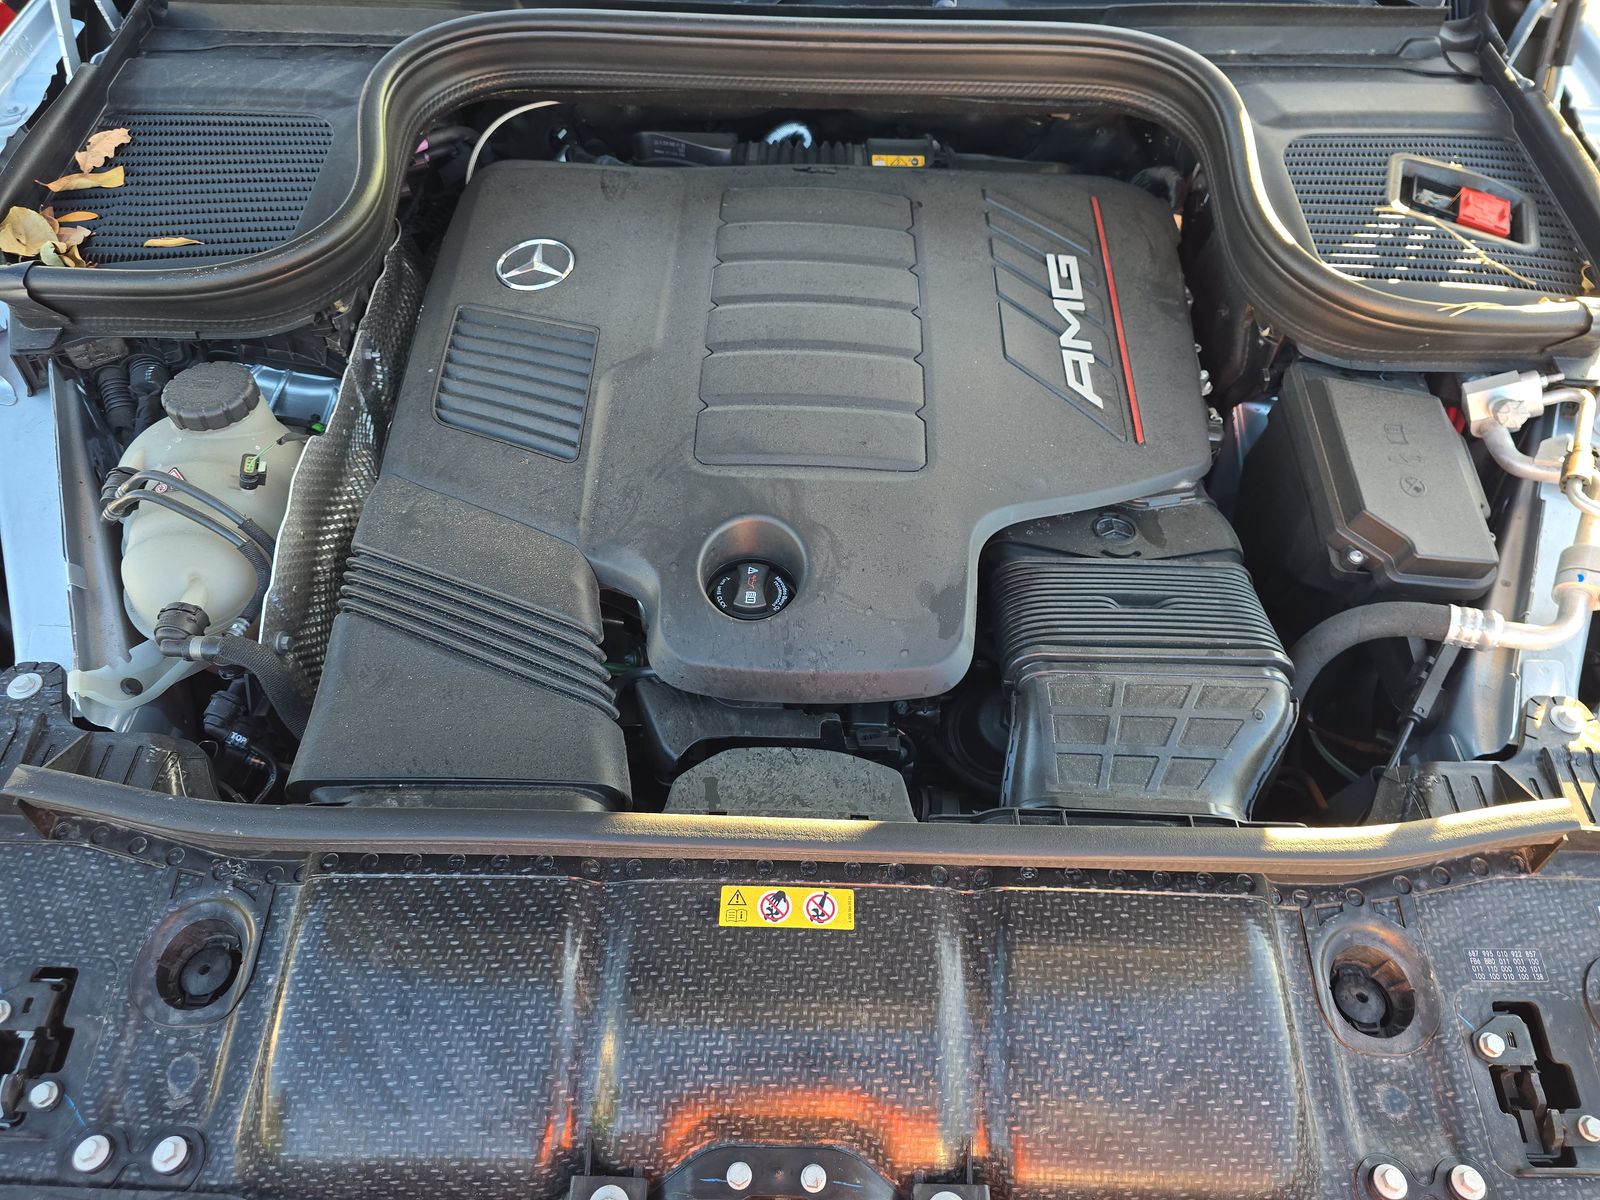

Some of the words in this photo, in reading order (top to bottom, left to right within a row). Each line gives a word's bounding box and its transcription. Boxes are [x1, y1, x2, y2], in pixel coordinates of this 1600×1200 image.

[1046, 253, 1104, 409] AMG
[716, 596, 728, 608] CLICK
[230, 731, 248, 743] TOP
